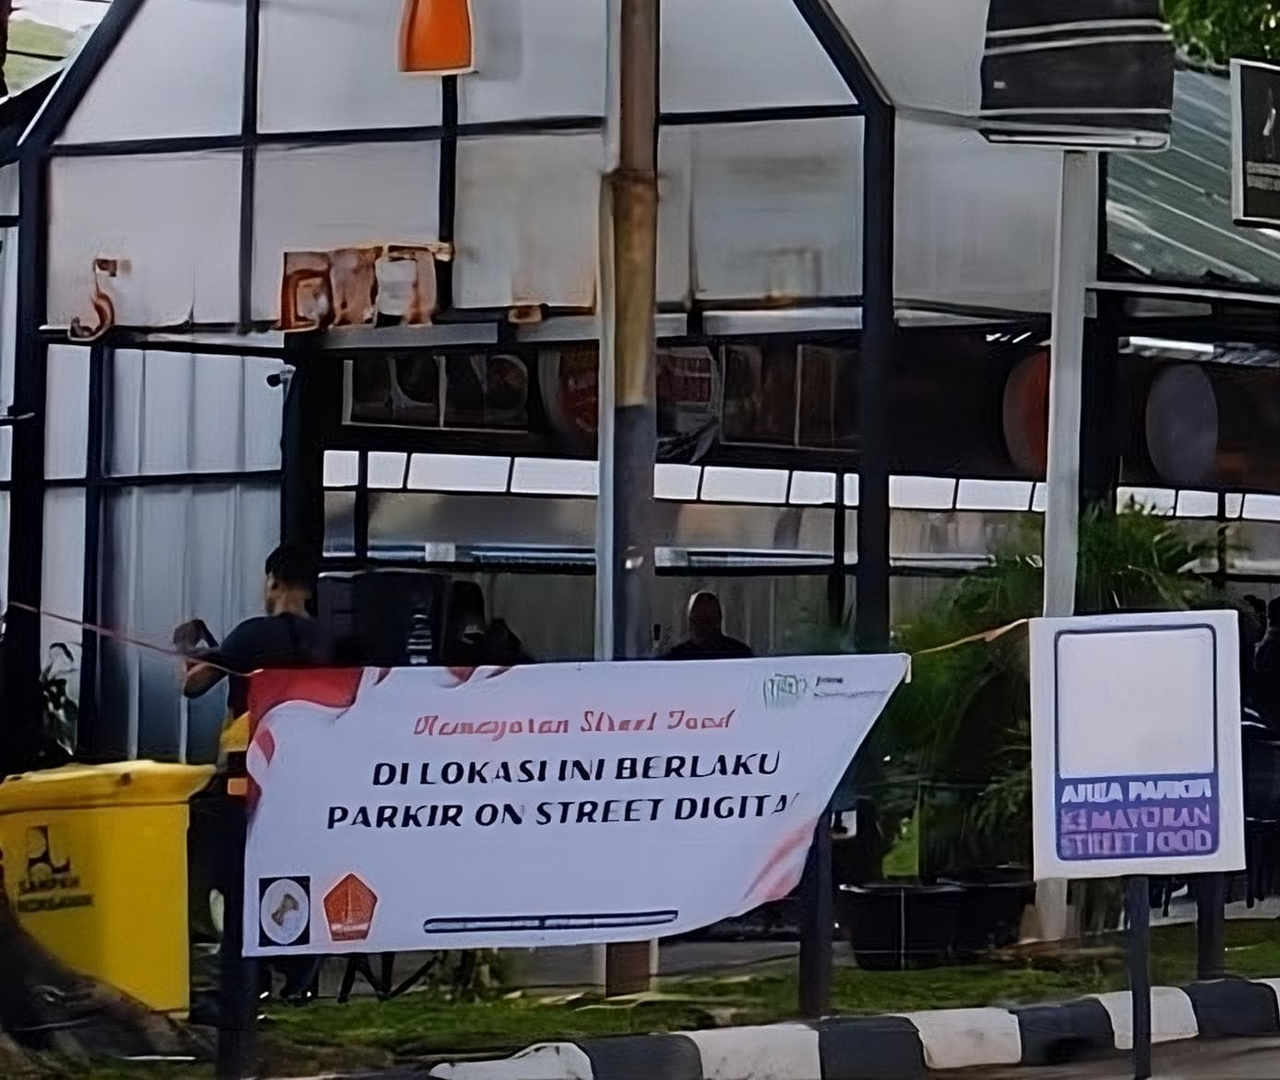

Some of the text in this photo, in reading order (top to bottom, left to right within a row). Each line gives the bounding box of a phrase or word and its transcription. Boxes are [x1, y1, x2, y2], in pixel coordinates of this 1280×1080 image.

[371, 750, 780, 786] DI LOKASI INI BERLAKU
[327, 804, 464, 829] PARKIR
[475, 803, 525, 827] ON
[535, 798, 665, 825] STREET
